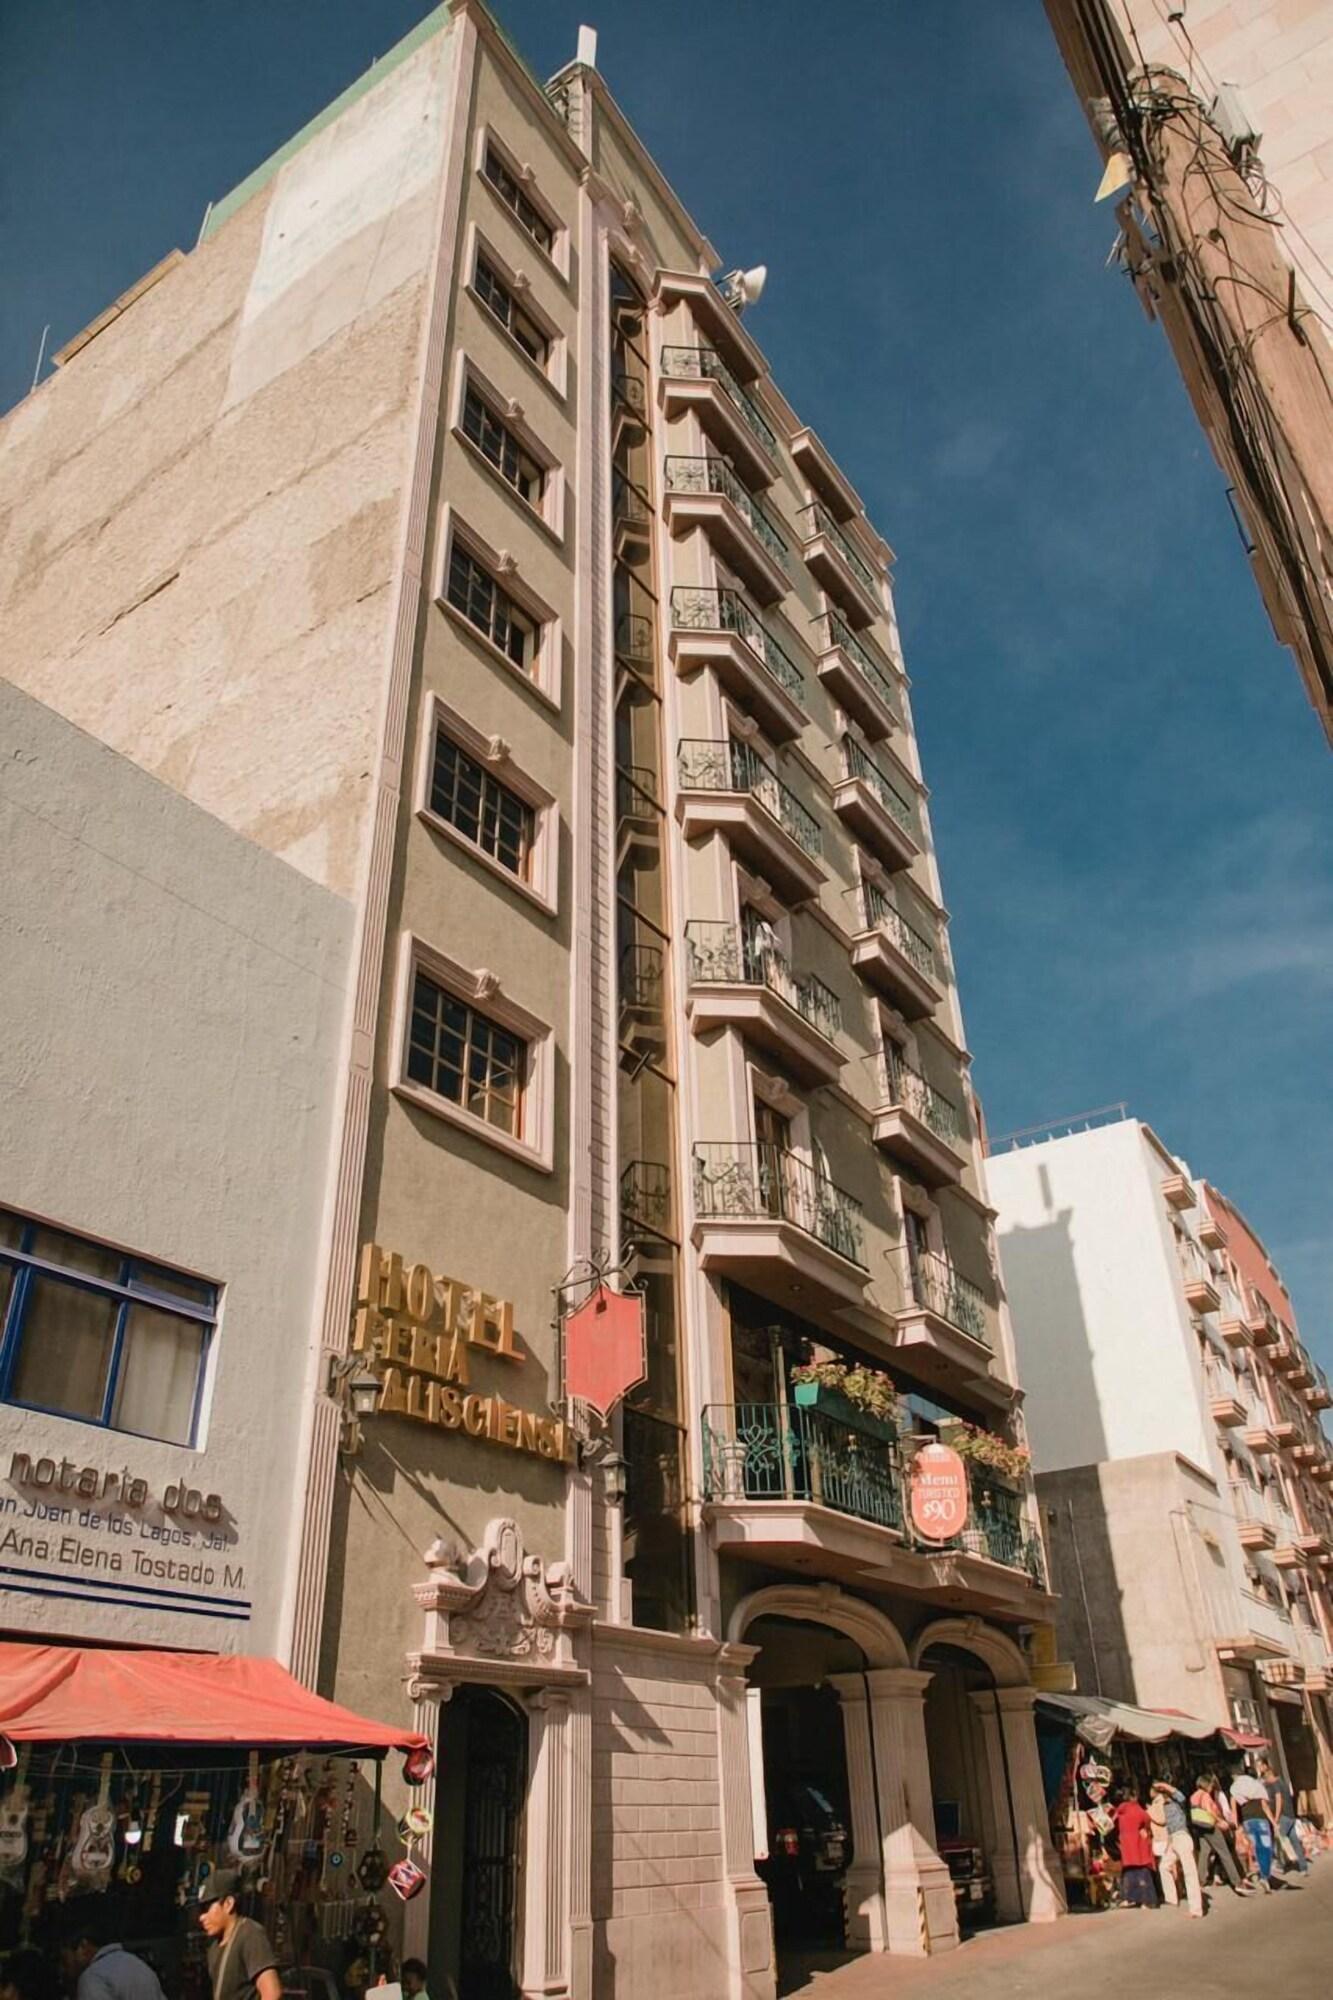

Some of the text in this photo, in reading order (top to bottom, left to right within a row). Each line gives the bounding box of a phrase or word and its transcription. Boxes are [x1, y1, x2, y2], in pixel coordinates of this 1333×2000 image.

[357, 1243, 526, 1361] HOTEL
[23, 1499, 72, 1525] Juan
[78, 1508, 101, 1530] de
[107, 1512, 133, 1536] los
[161, 1477, 223, 1522] dos
[923, 1499, 956, 1521] $90
[0, 1528, 246, 1591] Ana Elena Tostado M.
